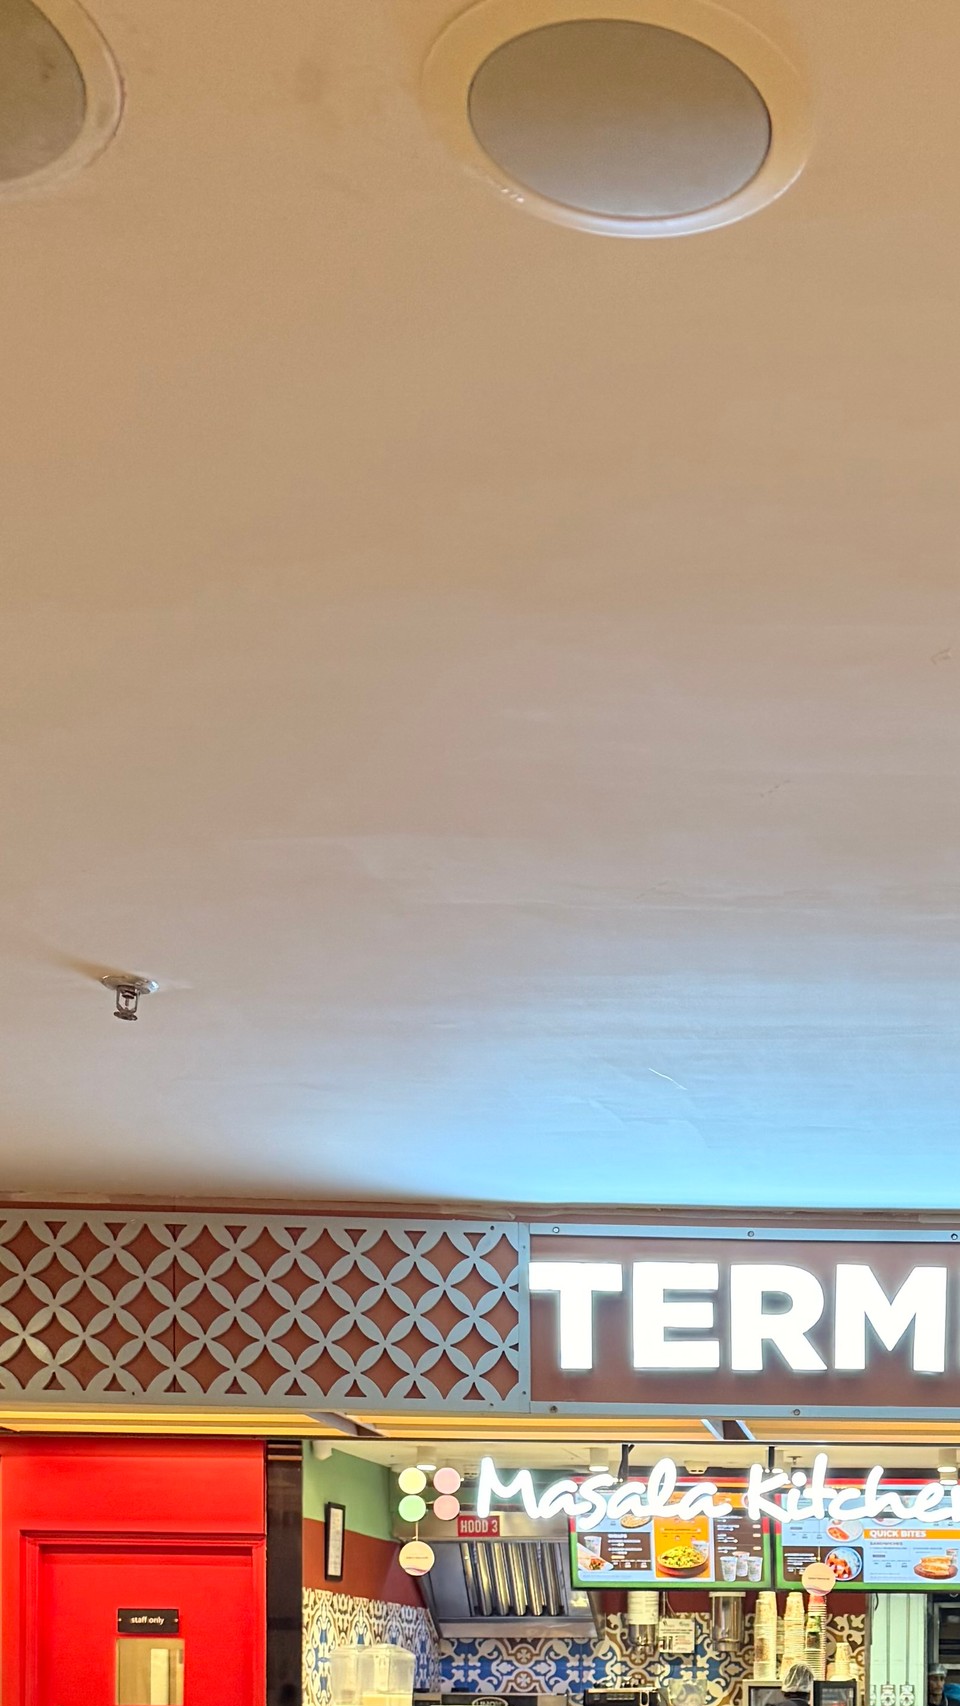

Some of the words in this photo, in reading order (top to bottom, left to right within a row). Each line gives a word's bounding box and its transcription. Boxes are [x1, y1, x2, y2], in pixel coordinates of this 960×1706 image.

[476, 1456, 731, 1530] Masala
[460, 1519, 488, 1533] HOOD
[491, 1519, 498, 1533] 3
[869, 1530, 899, 1538] QUICK
[901, 1530, 927, 1538] BITES
[130, 1616, 148, 1624] staff
[148, 1616, 165, 1625] only
